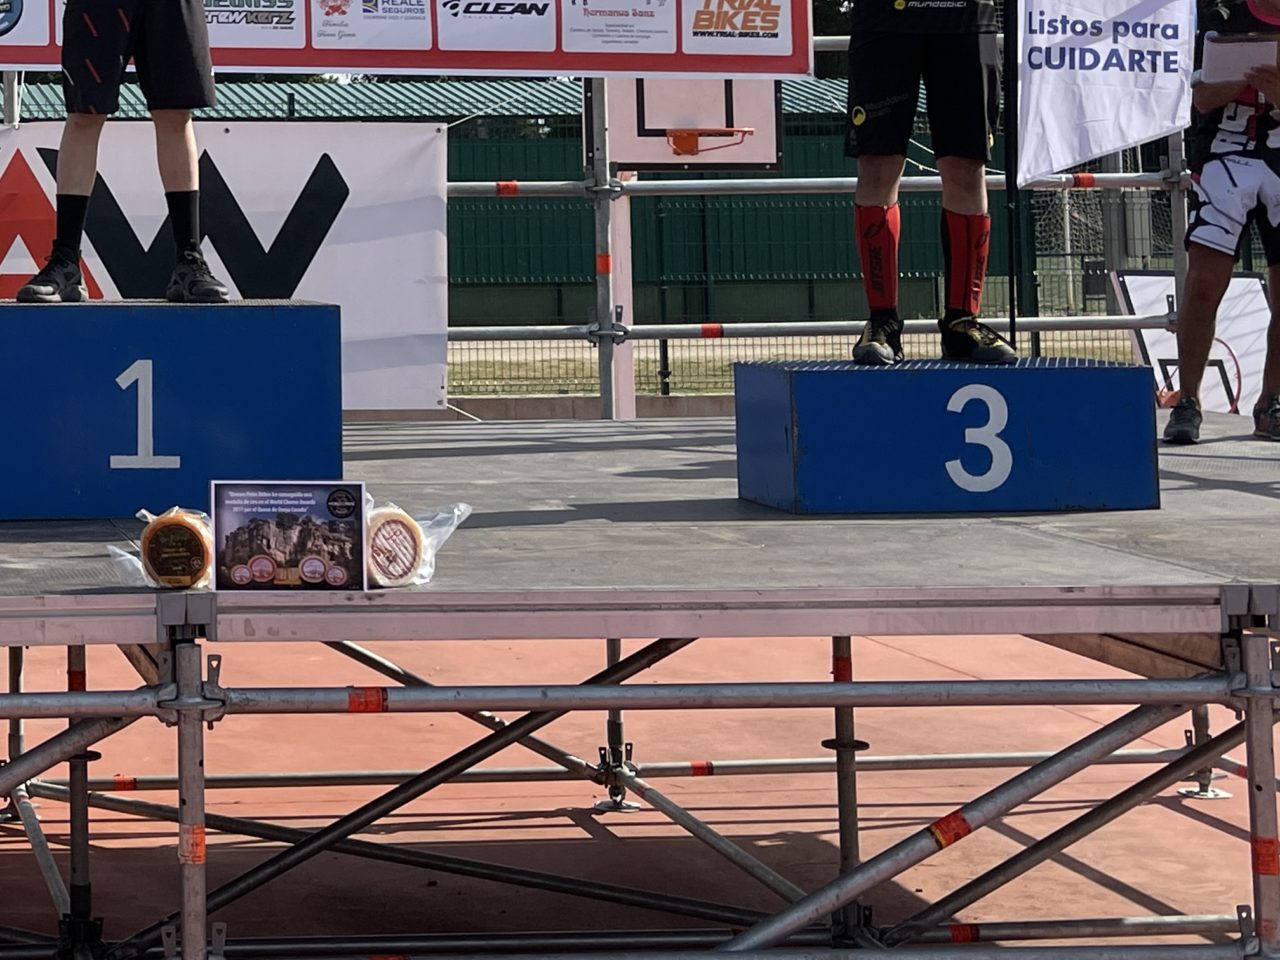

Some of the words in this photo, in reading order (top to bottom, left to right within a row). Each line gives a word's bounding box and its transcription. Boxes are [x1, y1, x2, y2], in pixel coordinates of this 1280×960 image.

[463, 2, 550, 16] CLEAN
[692, 10, 780, 31] BIKES
[1028, 10, 1103, 37] Listos
[1112, 20, 1179, 43] para
[1027, 46, 1179, 73] CUIDARTE
[109, 359, 181, 470] 1
[945, 383, 1014, 493] 3
